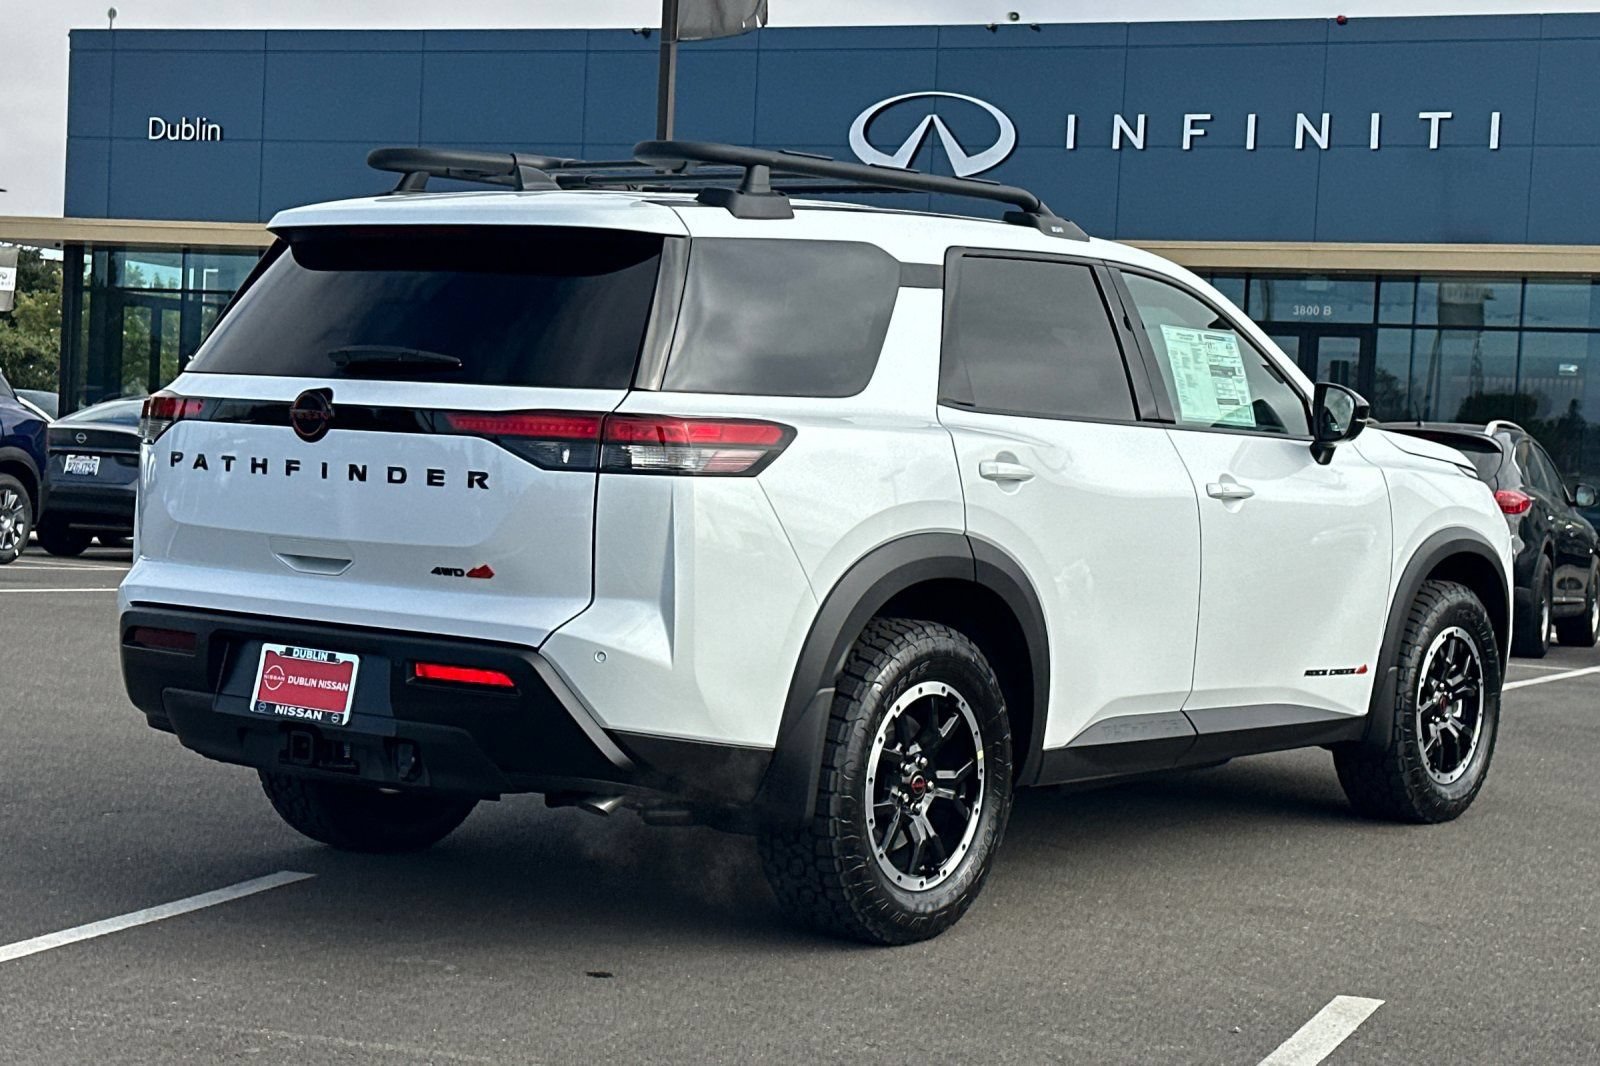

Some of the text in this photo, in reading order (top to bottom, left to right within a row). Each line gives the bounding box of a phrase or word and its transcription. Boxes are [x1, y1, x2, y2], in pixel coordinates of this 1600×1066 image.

[148, 116, 221, 141] Dublin
[1065, 111, 1502, 151] INFINITI
[1292, 304, 1332, 316] 3800 B
[169, 451, 490, 490] PATHFINDER
[430, 566, 465, 577] 4WD
[292, 649, 328, 662] DUBLIN
[287, 675, 349, 691] DUBLIN NISSAN
[274, 705, 322, 720] NISSAN
